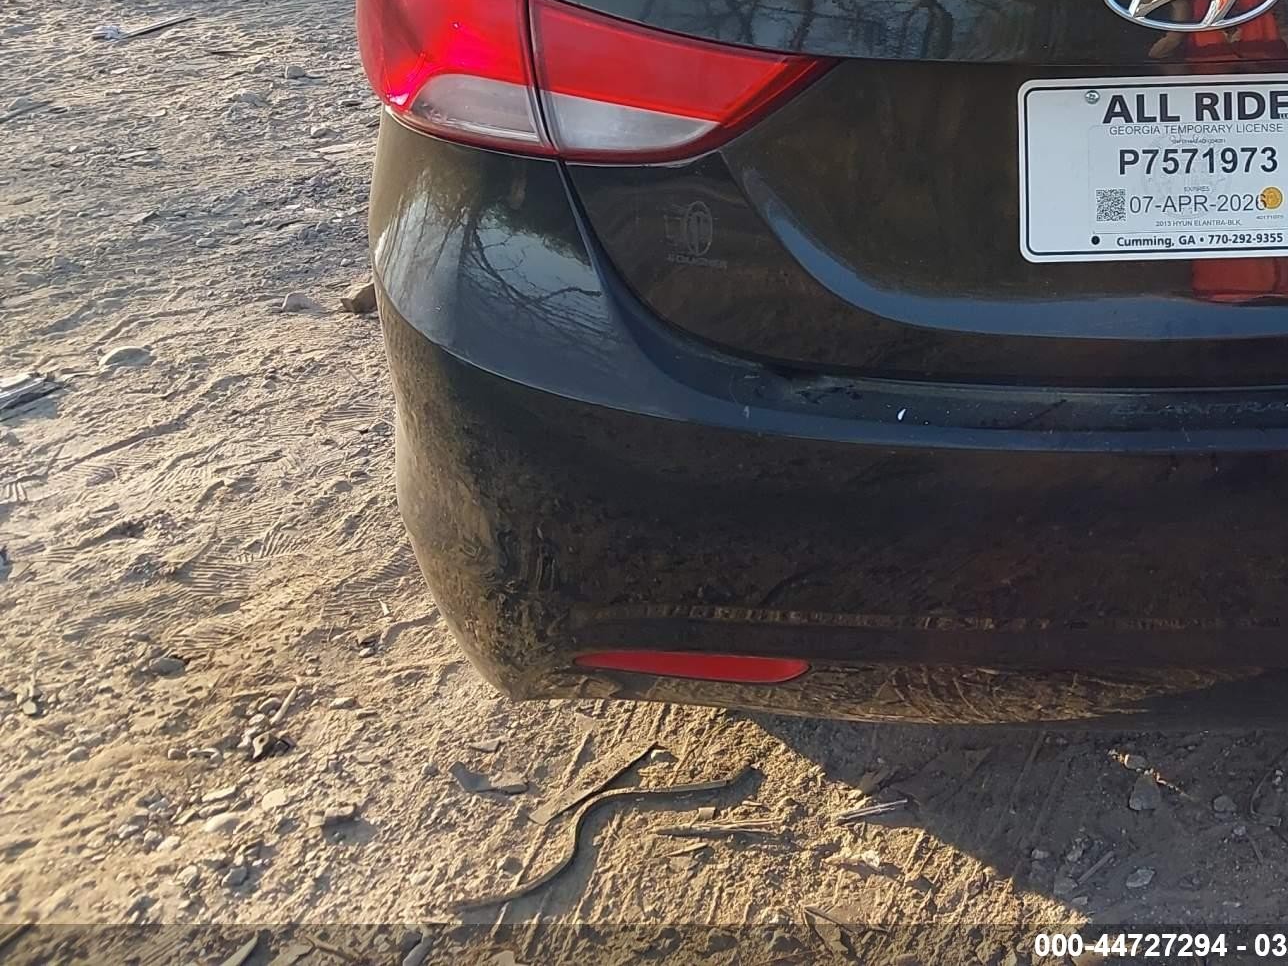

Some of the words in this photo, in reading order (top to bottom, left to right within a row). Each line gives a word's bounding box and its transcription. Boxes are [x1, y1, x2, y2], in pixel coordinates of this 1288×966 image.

[1102, 94, 1181, 124] ALL
[1109, 125, 1161, 135] GEORGIA
[1164, 123, 1233, 135] TEMPORARY
[1236, 122, 1284, 133] LICENSE
[1118, 146, 1279, 175] P7571973
[1129, 194, 1267, 214] 07-APR-2026
[1116, 236, 1175, 248] Cumming,
[1178, 234, 1196, 245] GA
[1207, 232, 1284, 245] 770-292-9355
